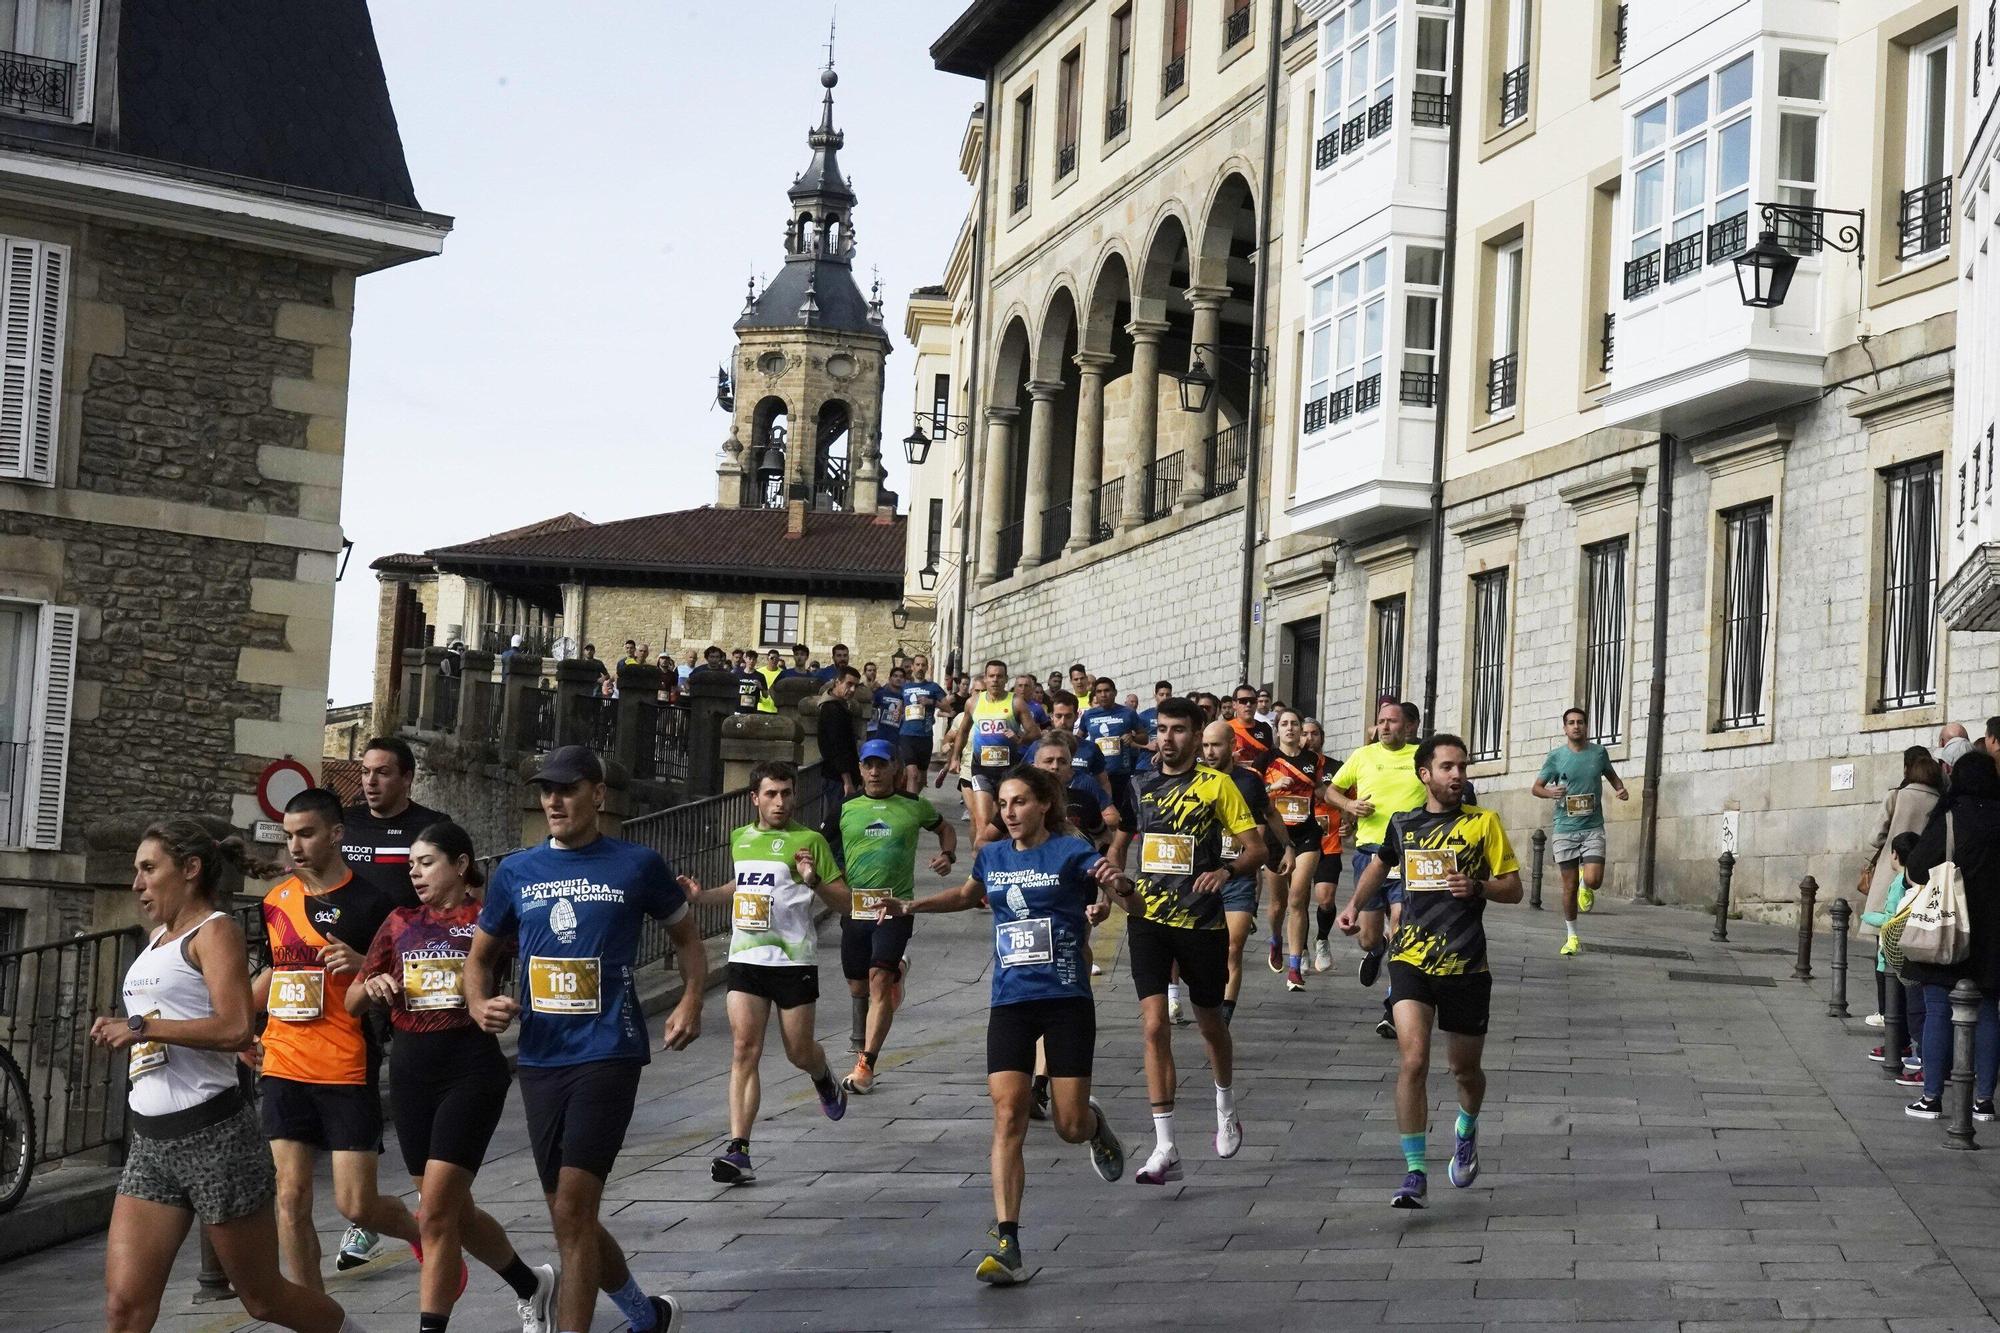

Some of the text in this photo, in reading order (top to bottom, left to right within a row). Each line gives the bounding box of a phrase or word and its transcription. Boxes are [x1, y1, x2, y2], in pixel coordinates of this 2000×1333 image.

[1287, 803, 1300, 812] 45
[1158, 844, 1176, 859] 85
[995, 869, 1036, 878] CONQUISTA
[1416, 860, 1443, 876] 363
[521, 878, 590, 895] LA CONQUISTA
[736, 872, 775, 887] LEA
[994, 872, 1049, 886] ALMENDRA
[1021, 879, 1060, 889] KONKISTA
[534, 884, 611, 901] ALMENDRA
[574, 894, 625, 904] KONKISTA
[1009, 930, 1035, 950] 755
[421, 971, 456, 990] 239
[548, 972, 577, 993] 113
[279, 983, 305, 1002] 463
